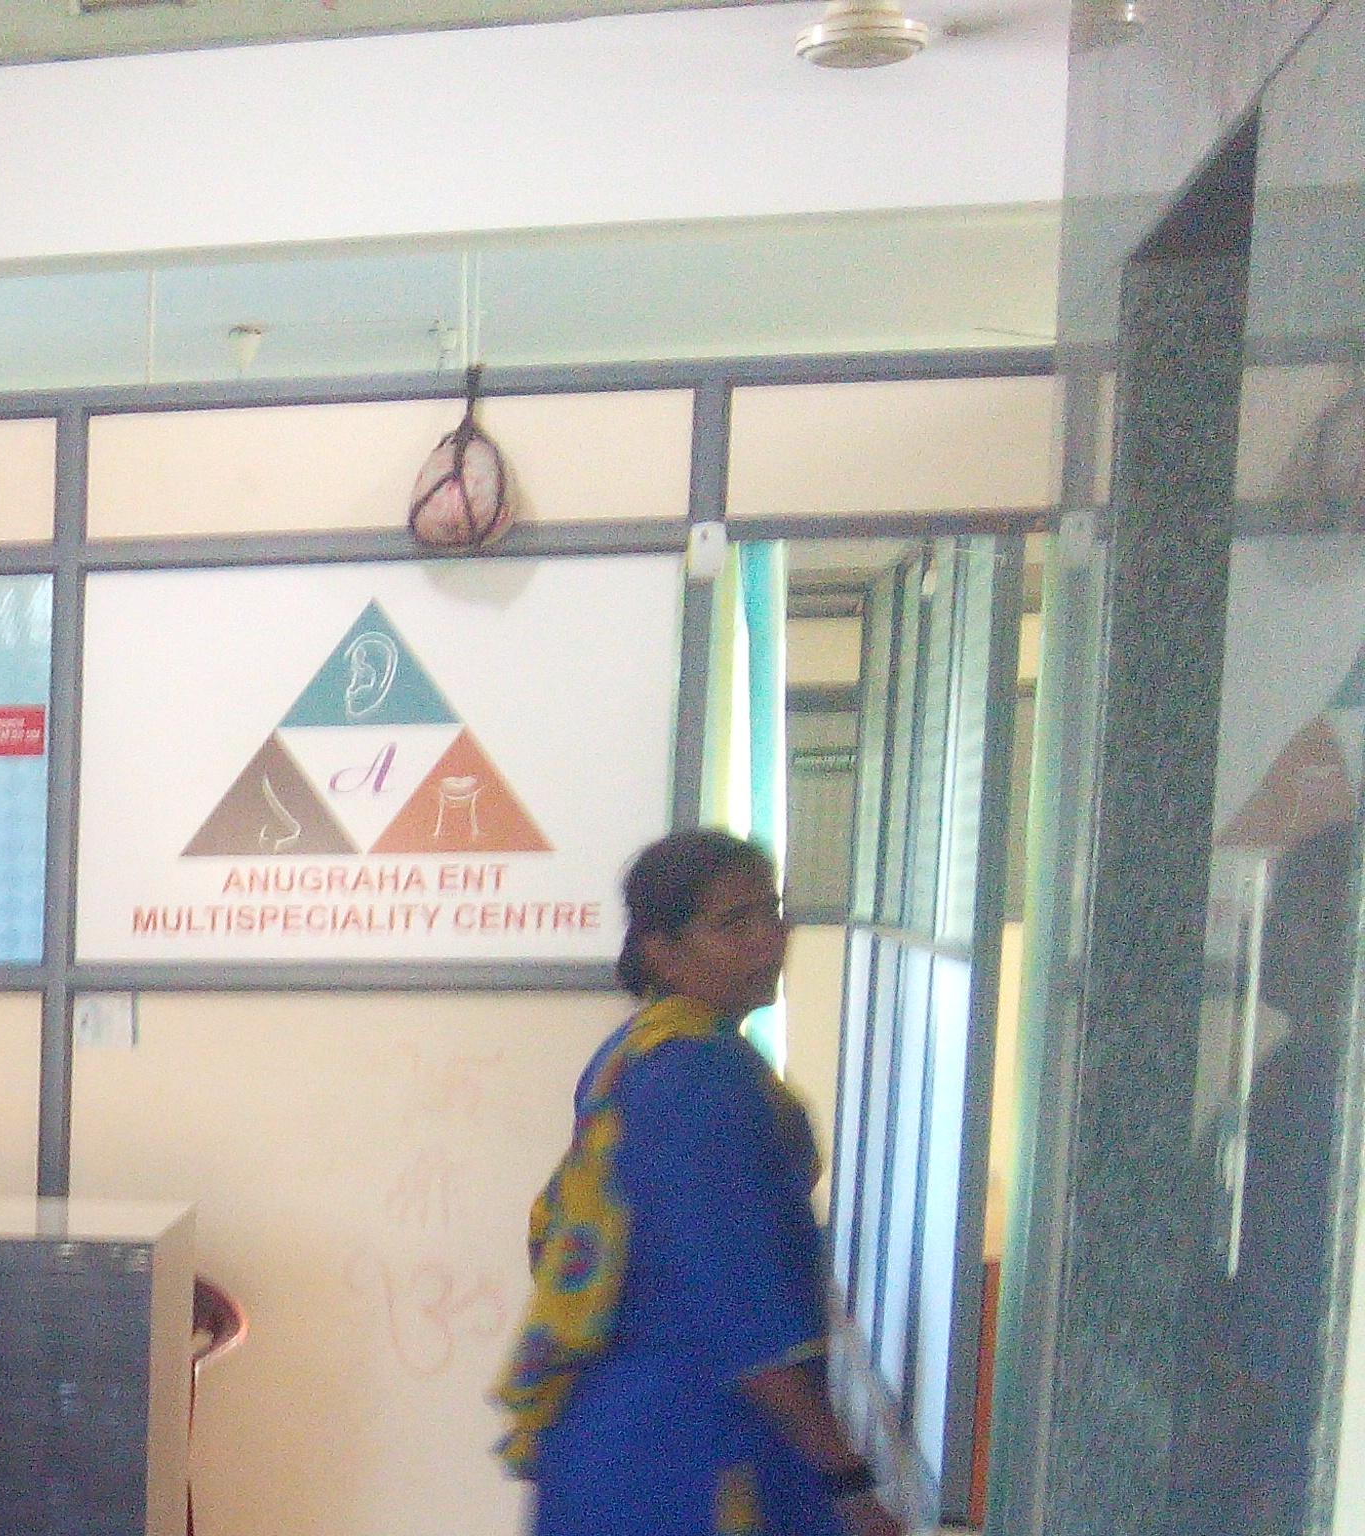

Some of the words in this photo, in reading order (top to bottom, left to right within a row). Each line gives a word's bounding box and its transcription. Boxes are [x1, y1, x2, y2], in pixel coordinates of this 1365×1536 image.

[222, 863, 424, 897] ANUGRAHA
[438, 863, 509, 894] ENT
[132, 902, 444, 936] MULTISPECIALITY
[452, 900, 603, 932] CENTRE
